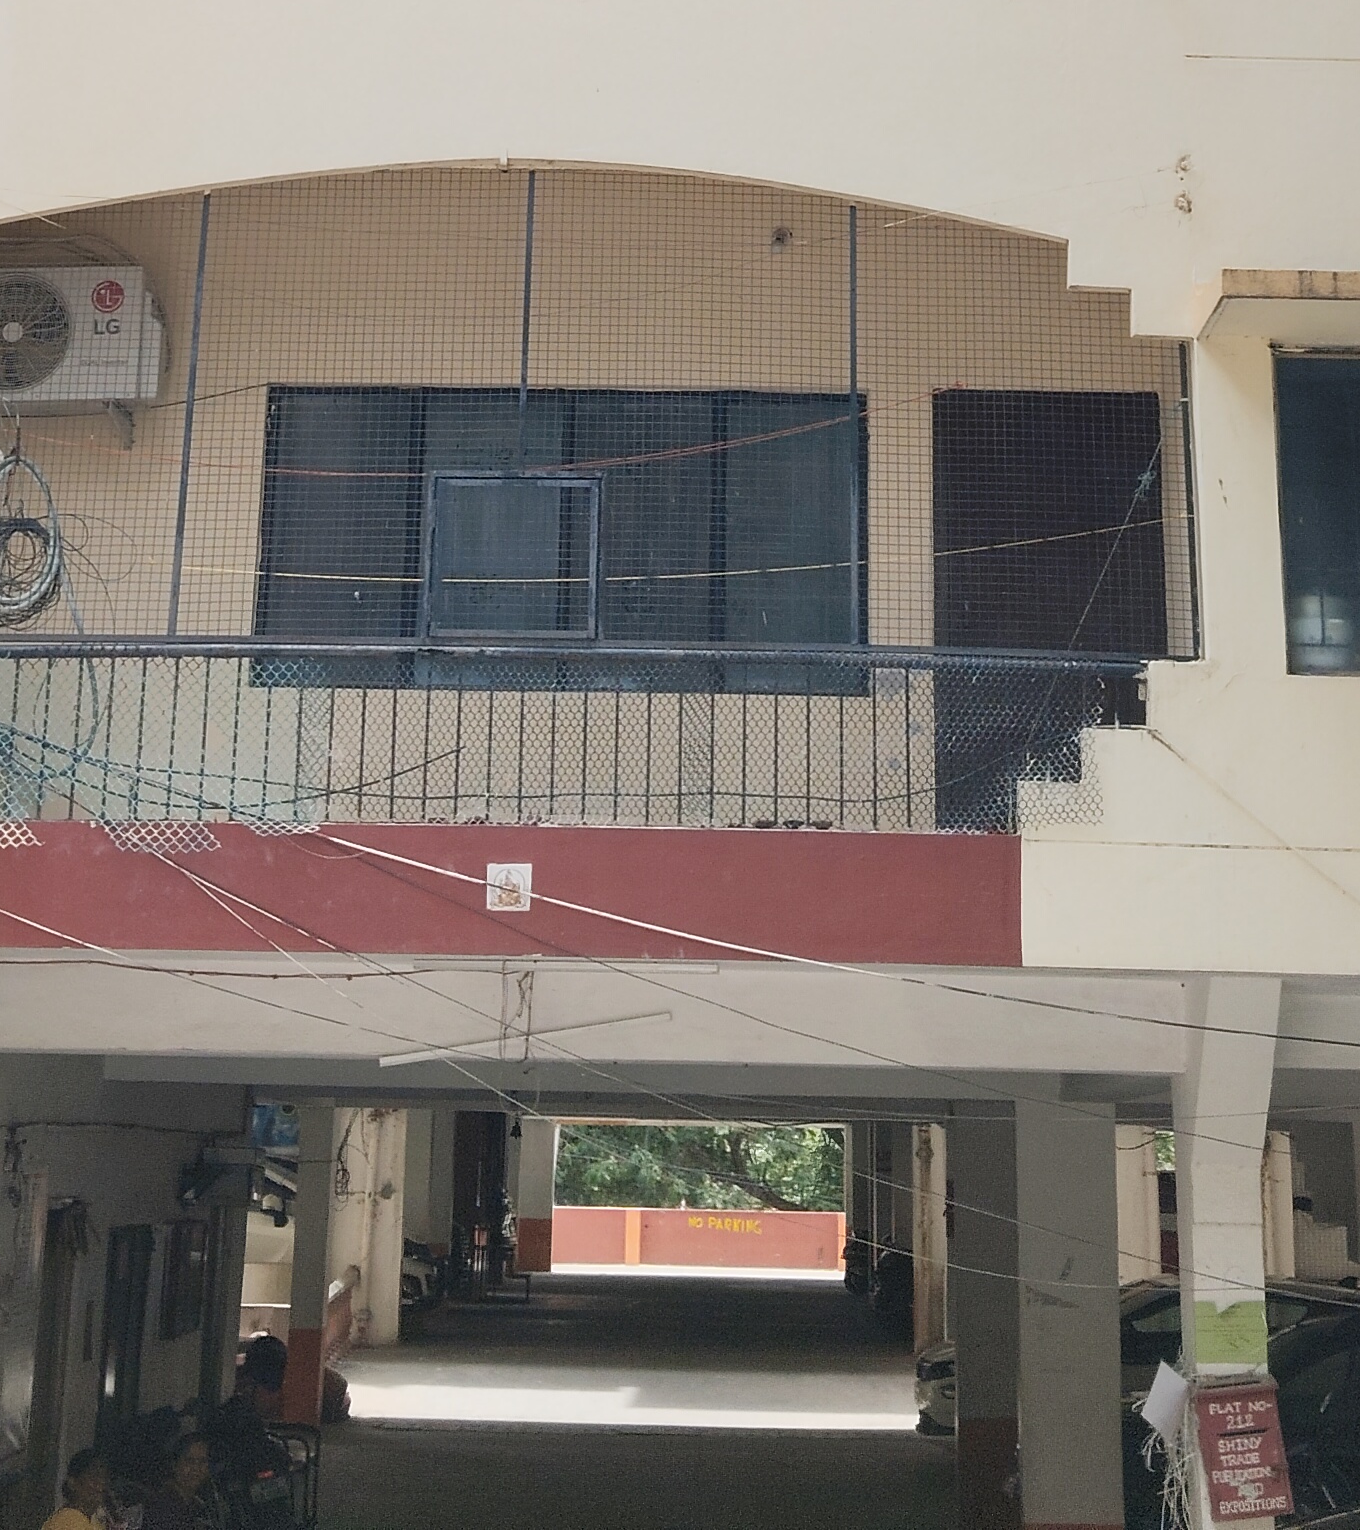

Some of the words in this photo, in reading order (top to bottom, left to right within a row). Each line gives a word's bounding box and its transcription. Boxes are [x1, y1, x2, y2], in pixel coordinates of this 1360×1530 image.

[94, 319, 121, 335] LG
[688, 1217, 703, 1228] NO
[708, 1216, 762, 1235] PARKING
[1208, 1401, 1242, 1415] FLAT
[1217, 1436, 1263, 1452] SHINY
[1220, 1452, 1261, 1467] TRADE
[1219, 1496, 1287, 1514] EXPOSITIONS
